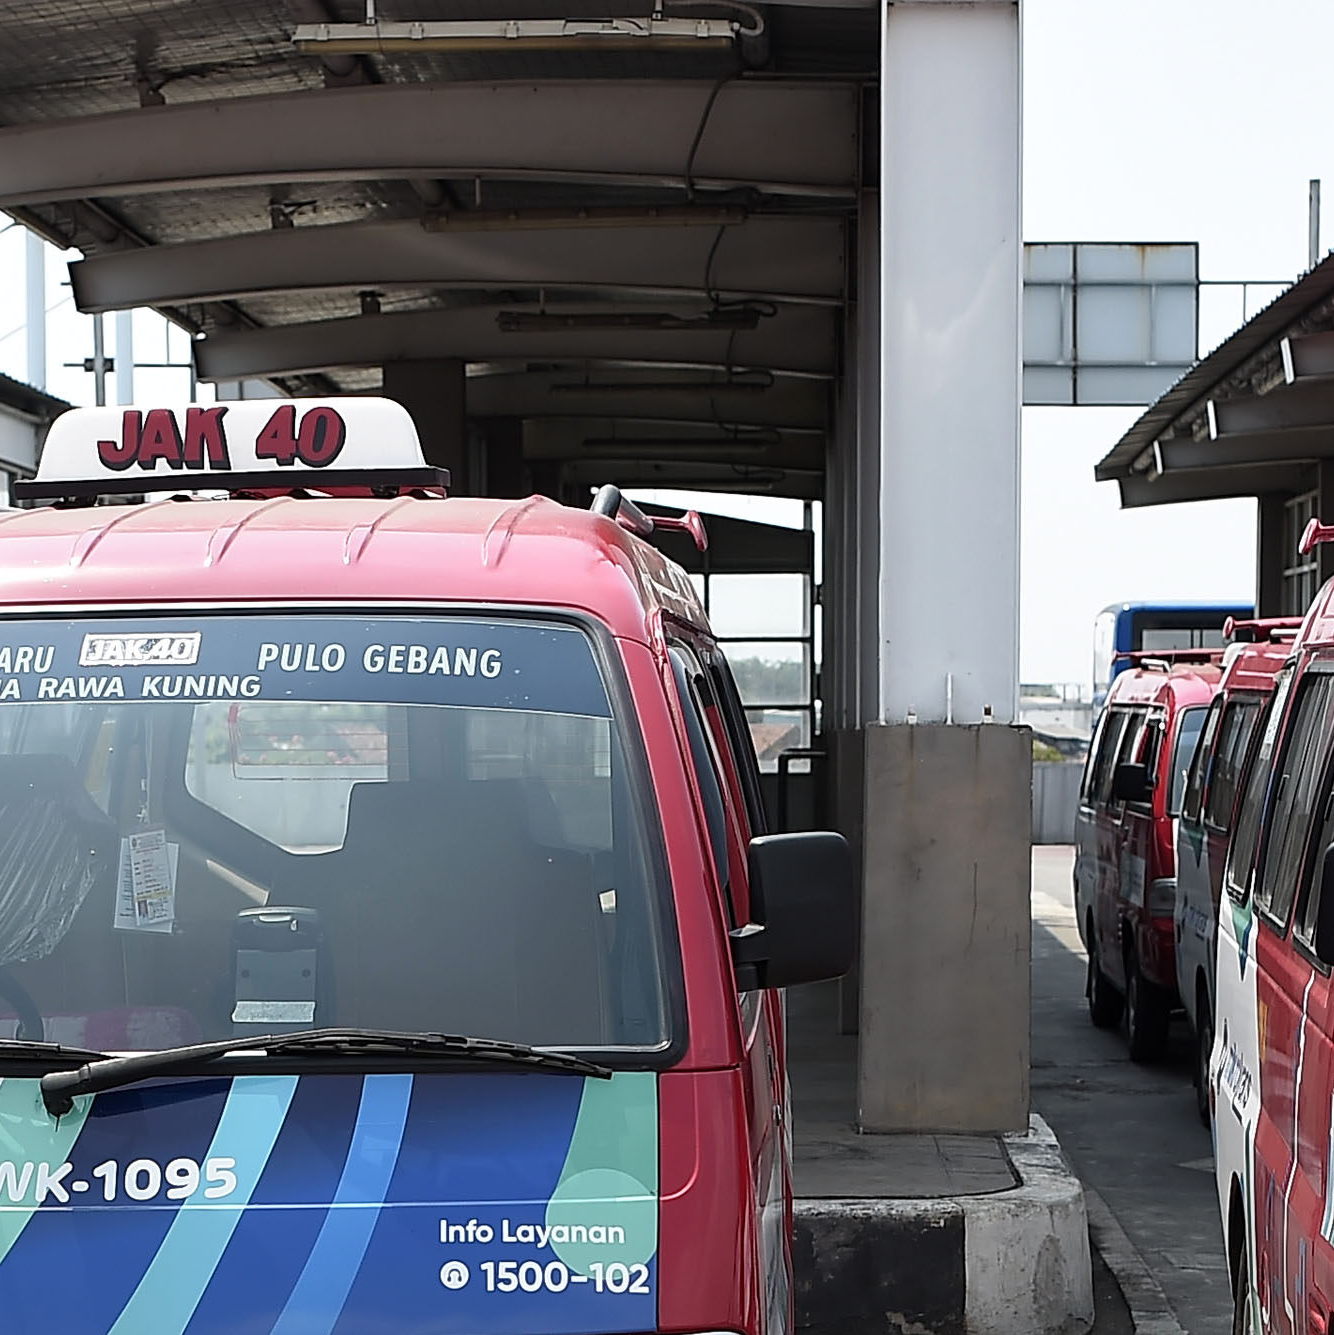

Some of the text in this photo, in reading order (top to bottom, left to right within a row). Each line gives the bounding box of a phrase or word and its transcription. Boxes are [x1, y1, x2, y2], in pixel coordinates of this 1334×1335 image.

[97, 405, 346, 470] JAK 40
[258, 643, 346, 672] PULO
[363, 644, 503, 679] GEBANG
[37, 676, 125, 699] RAWA
[142, 675, 261, 697] KUNING
[439, 1219, 625, 1248] Info Layanan
[480, 1261, 650, 1294] 1500-102
